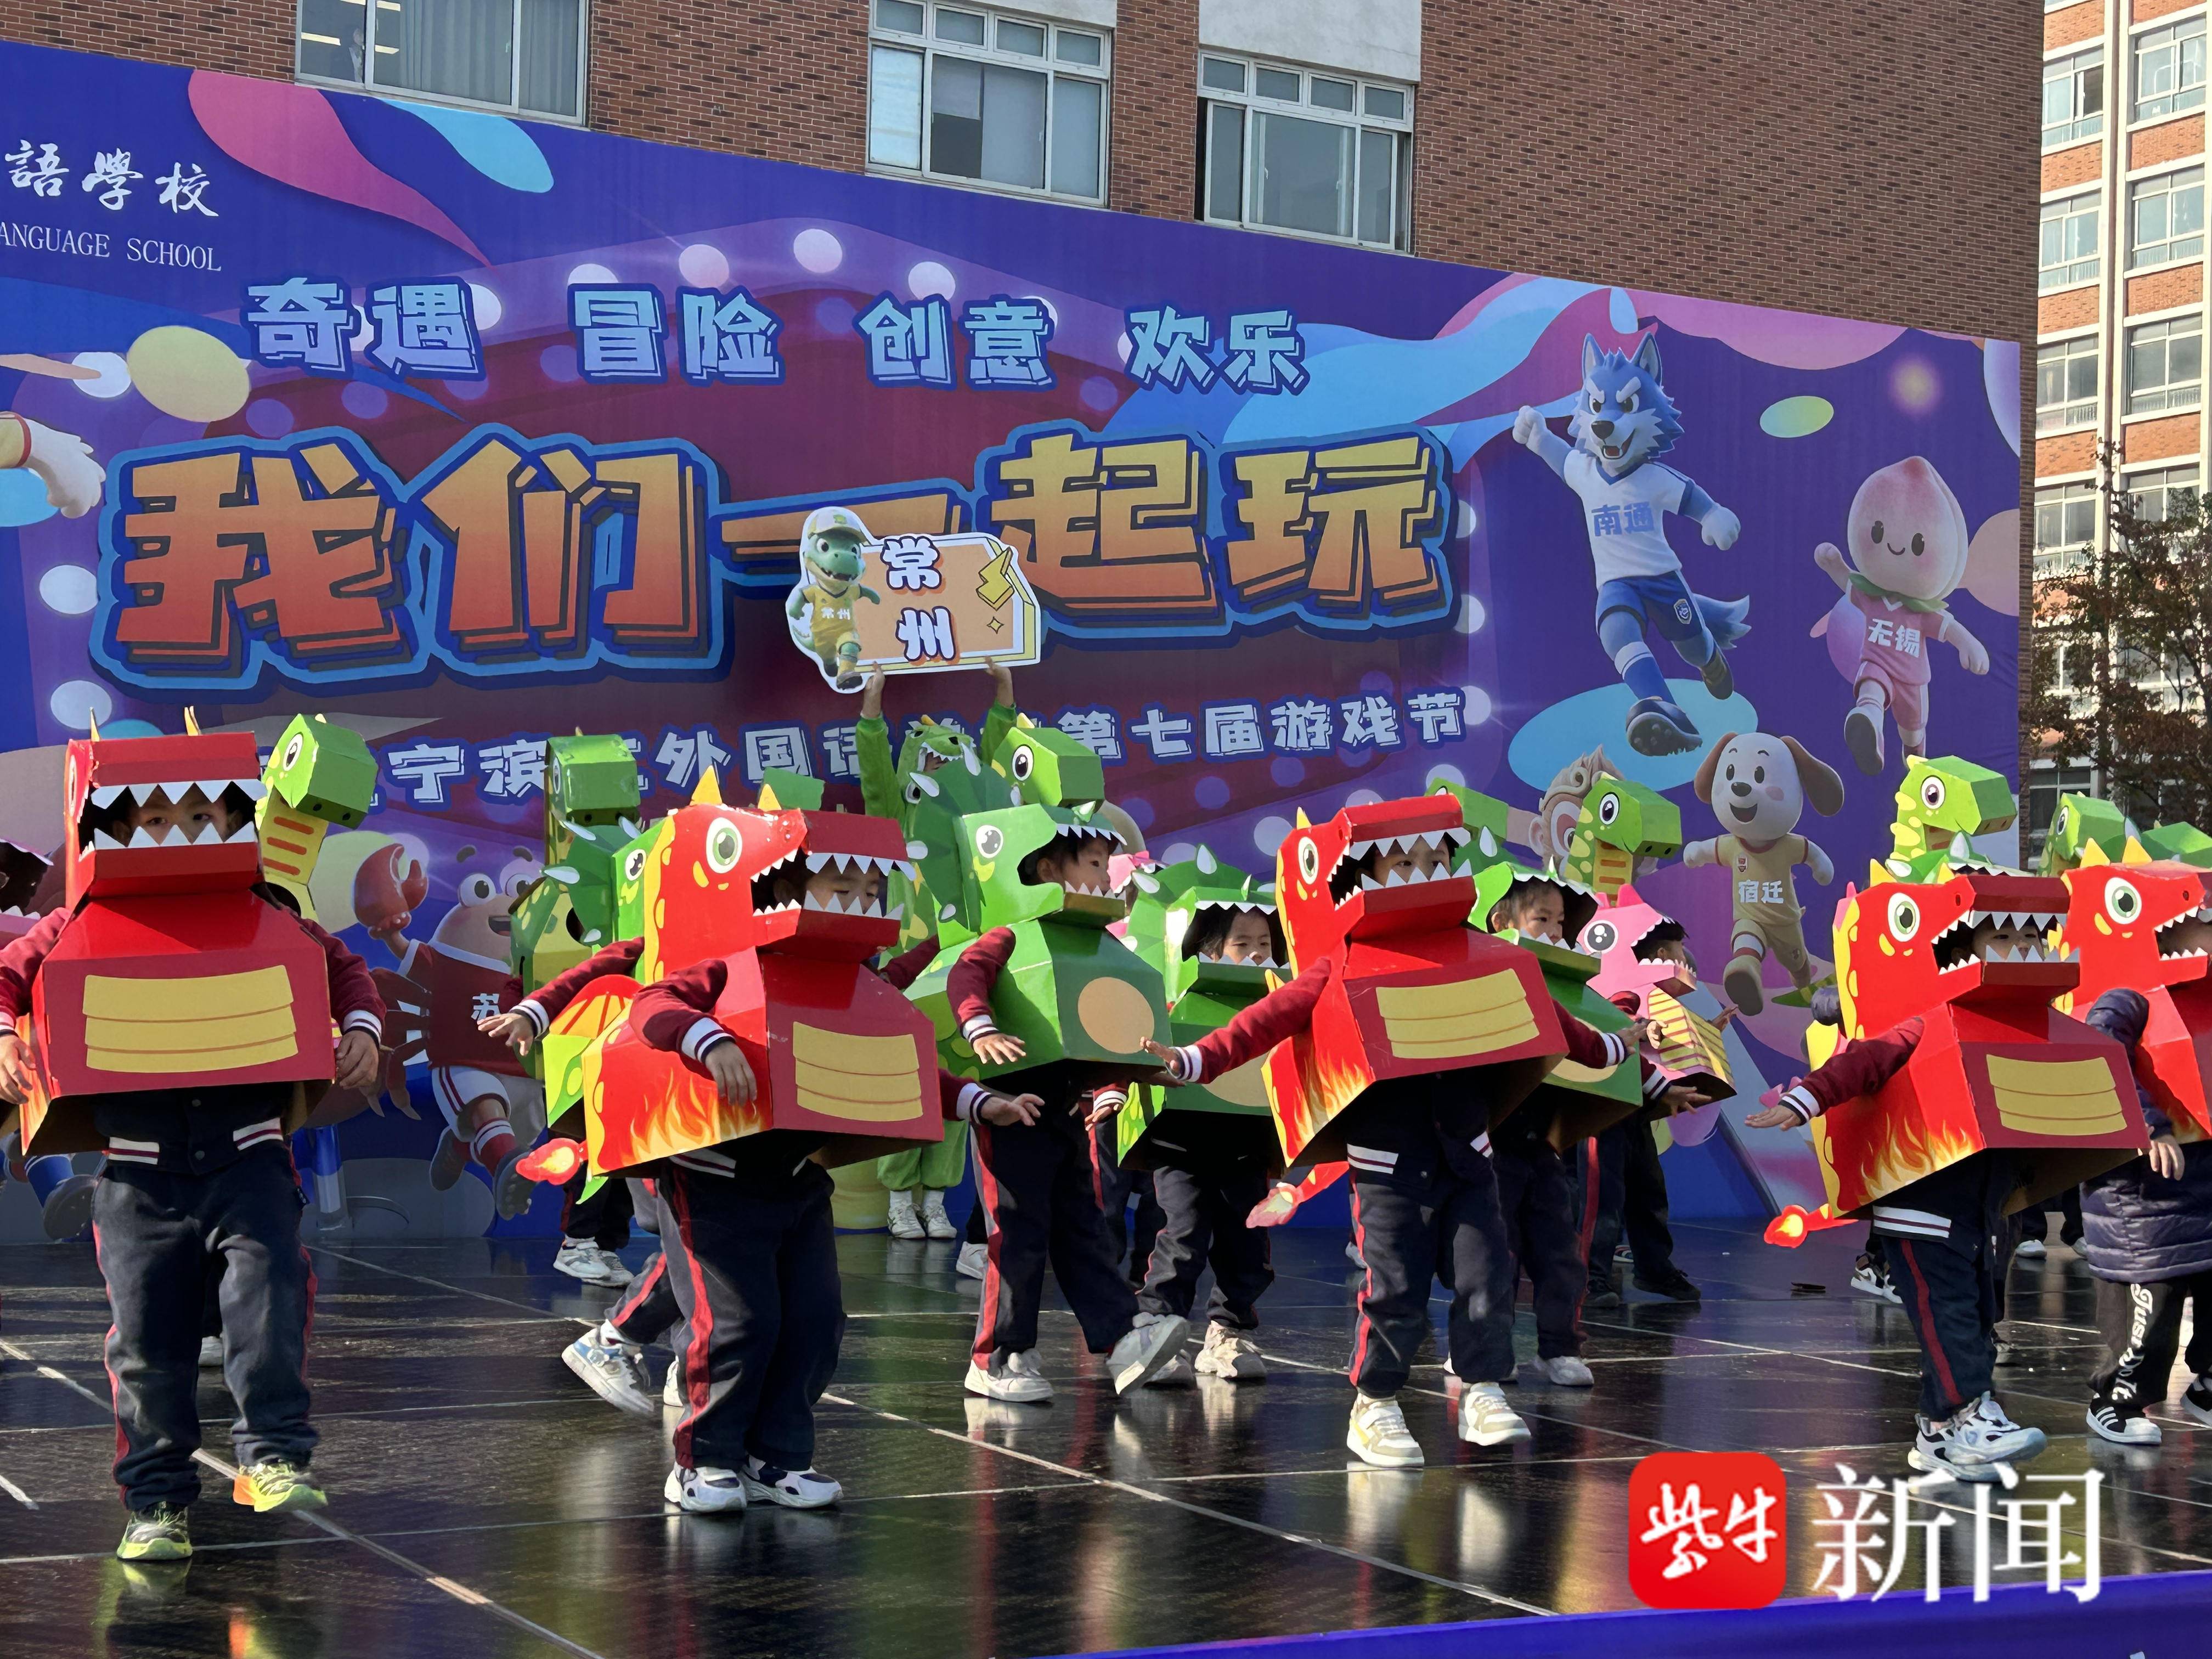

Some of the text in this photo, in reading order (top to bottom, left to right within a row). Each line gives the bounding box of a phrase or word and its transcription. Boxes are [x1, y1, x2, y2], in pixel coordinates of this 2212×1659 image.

[4, 139, 219, 217] 語學校
[127, 238, 222, 272] SCHOOL
[247, 276, 1305, 390] 奇遇 冒险 创意 欢乐
[114, 432, 1438, 658] 我们一起玩
[1591, 501, 1655, 537] 南通
[881, 536, 956, 662] 常州
[1868, 618, 1921, 658] 无锡
[1738, 879, 1784, 904] 宿迁
